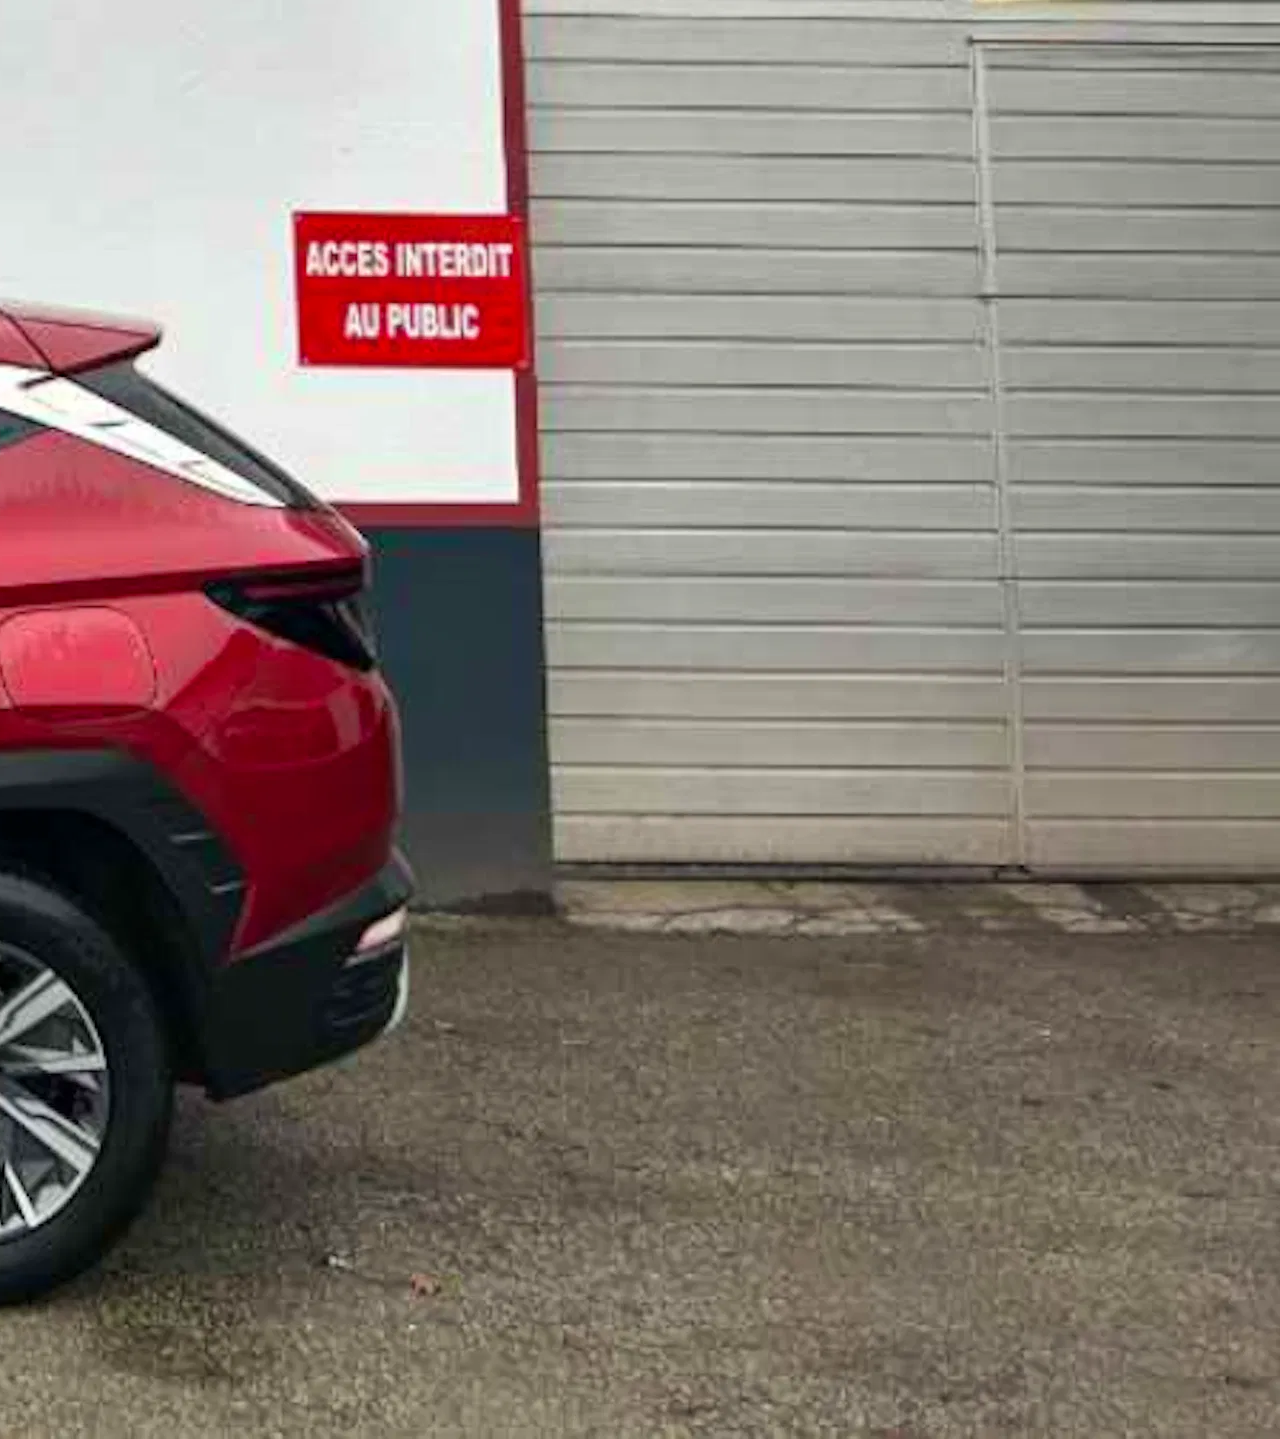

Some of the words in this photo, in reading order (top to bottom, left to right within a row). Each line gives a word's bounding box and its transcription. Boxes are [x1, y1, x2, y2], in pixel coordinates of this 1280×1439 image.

[305, 241, 389, 277] ACCES
[395, 242, 513, 278] INTERDIT
[344, 303, 380, 339] AU
[386, 303, 480, 339] PUBLIC
